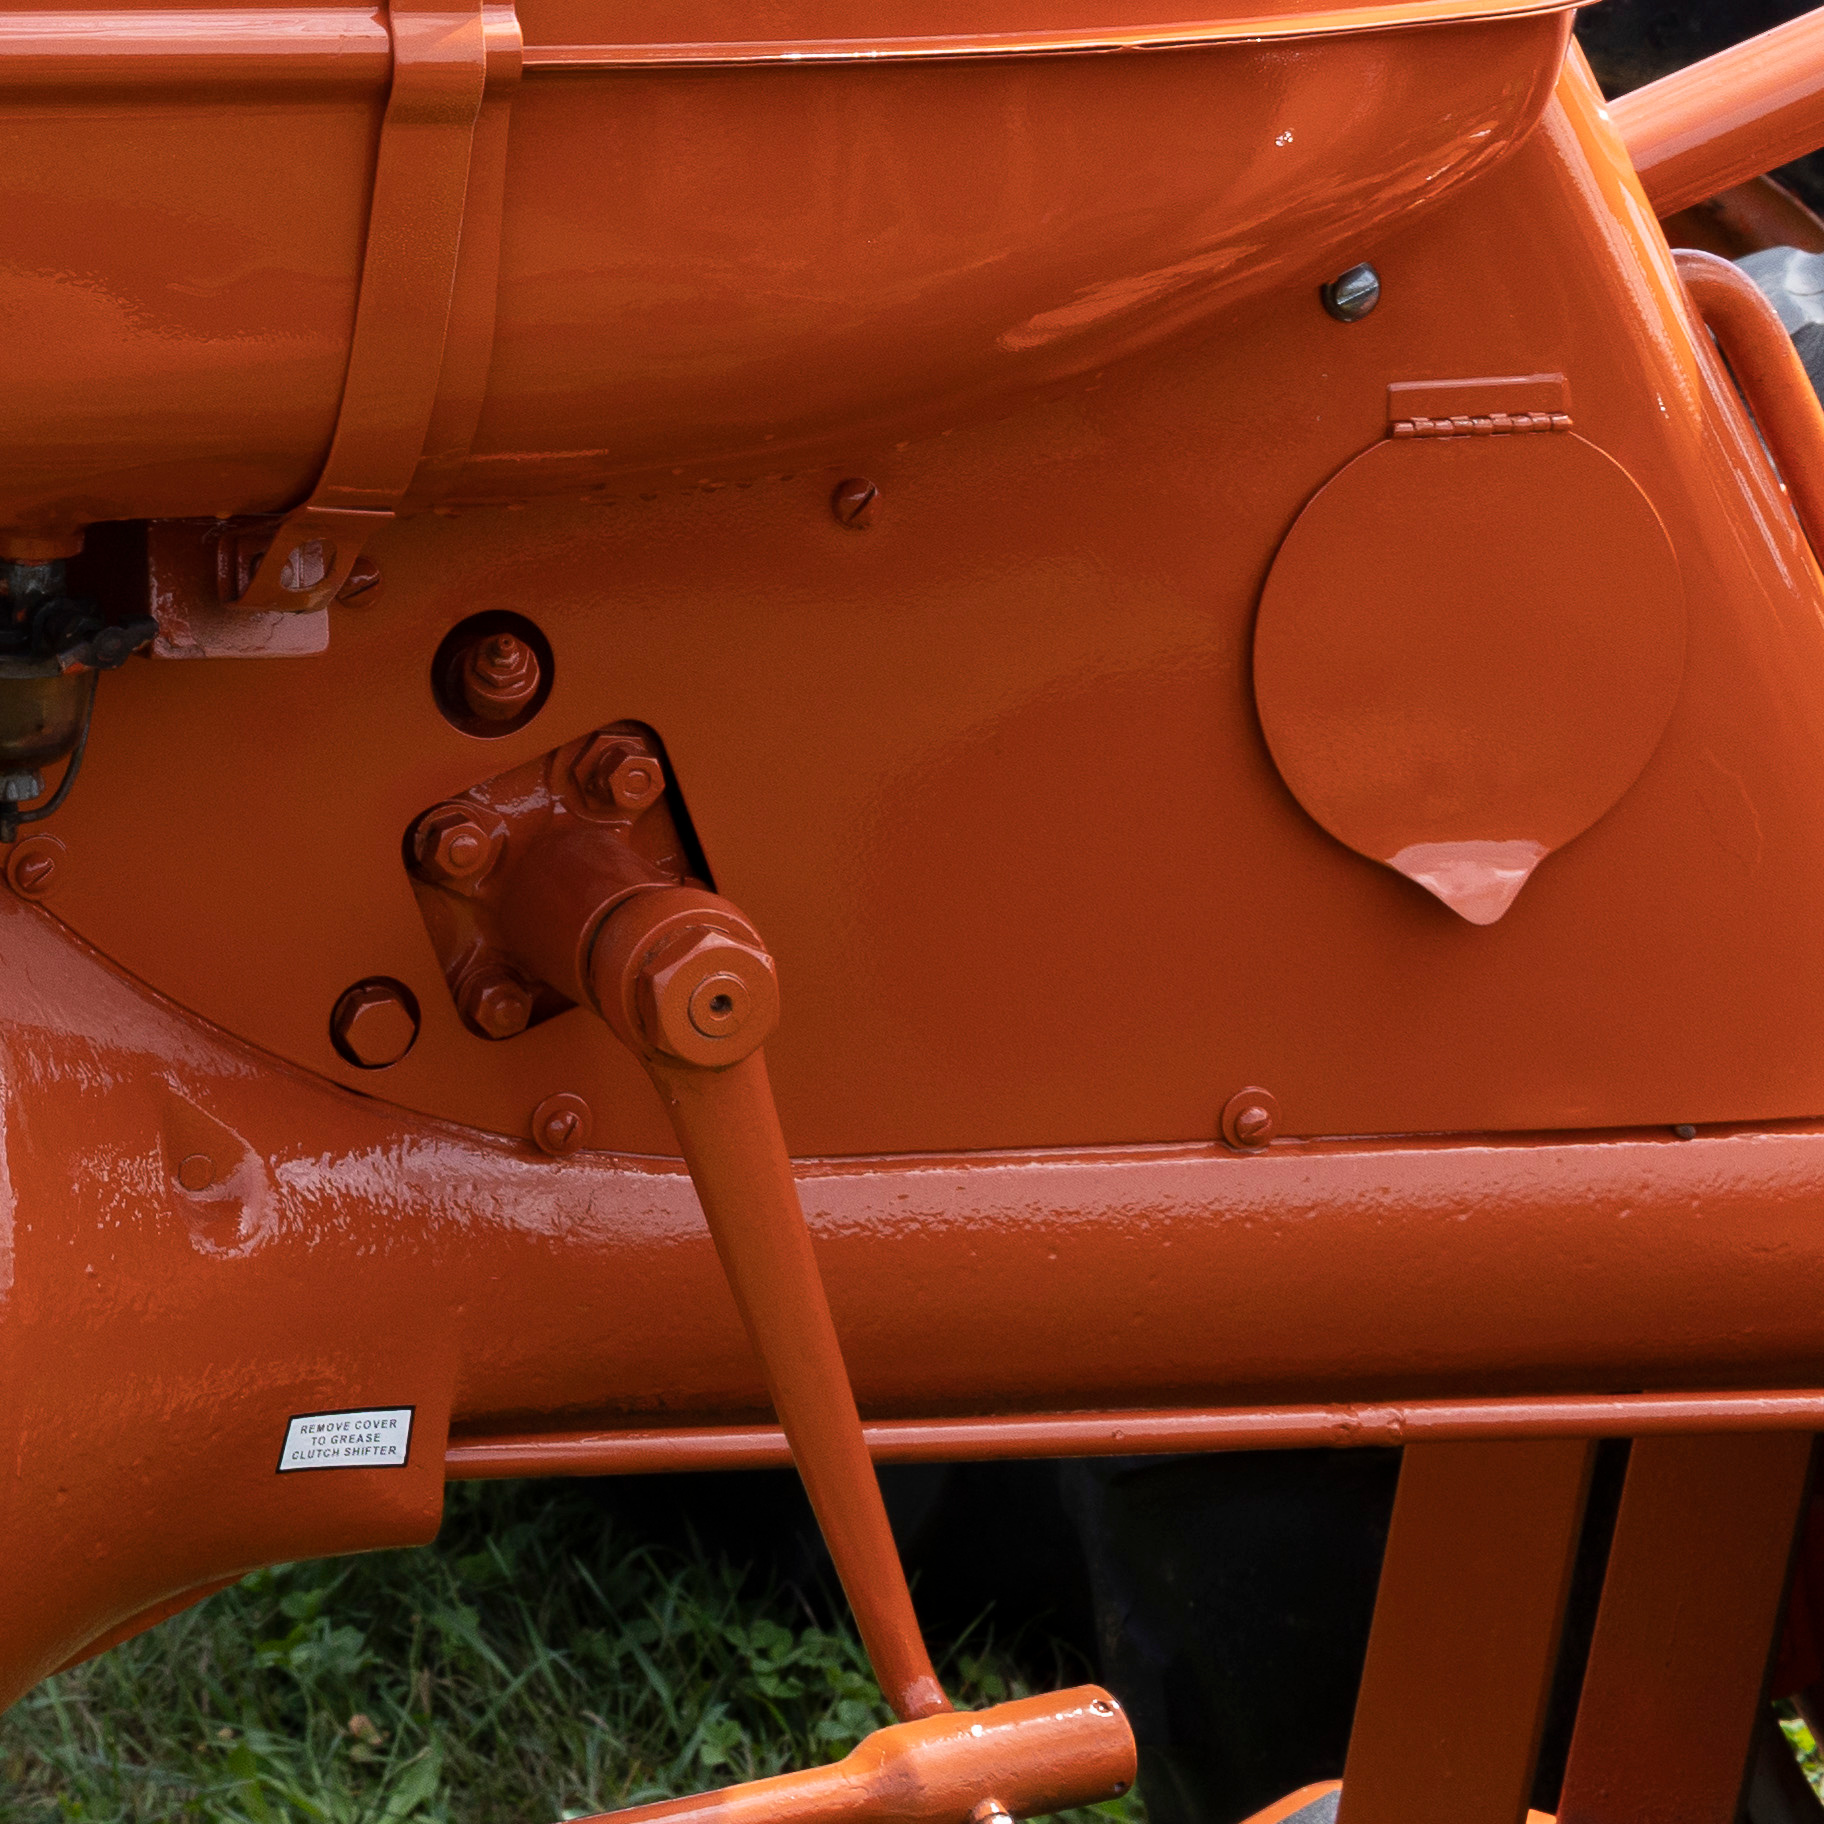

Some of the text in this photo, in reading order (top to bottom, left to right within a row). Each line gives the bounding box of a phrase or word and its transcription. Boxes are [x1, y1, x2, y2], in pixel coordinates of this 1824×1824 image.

[300, 1419, 398, 1435] REMOVE COVER
[311, 1433, 381, 1446] TO GREASE
[292, 1445, 397, 1460] CLUTCH SHIFTER
